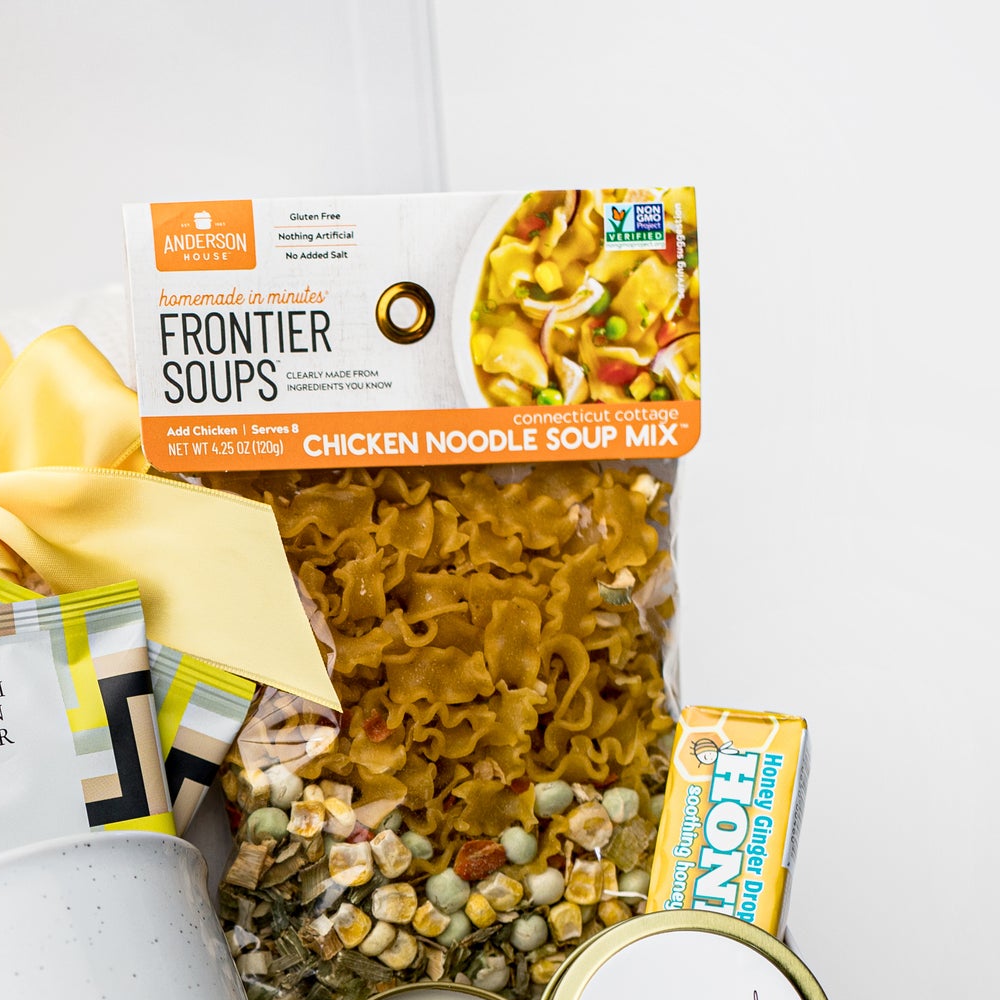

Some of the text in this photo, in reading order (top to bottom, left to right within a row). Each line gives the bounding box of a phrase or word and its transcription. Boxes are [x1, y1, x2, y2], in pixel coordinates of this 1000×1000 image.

[289, 212, 341, 221] Gluten Free
[636, 206, 660, 214] NON
[636, 214, 661, 222] GMO
[636, 222, 661, 230] Project
[164, 233, 247, 254] ANDERSON
[278, 230, 354, 242] Nothing Artificial
[608, 232, 662, 241] VERIFIED
[183, 252, 229, 261] HOUSE
[285, 250, 348, 260] No Added Salt
[674, 203, 687, 299] serving suggestion
[158, 286, 245, 307] homemade
[248, 289, 265, 305] in
[160, 310, 332, 355] FRONTIER
[286, 370, 379, 380] CLEARLY MADE FROM
[286, 381, 393, 392] INGREDIENTS YOU KNOW
[513, 407, 679, 425] connecticut cottage
[167, 423, 299, 437] Add Chicken Serves 8
[168, 440, 284, 456] NET WT 4.25 OZ (120g)
[303, 431, 419, 456] CHICKEN
[426, 428, 538, 453] NOODLE
[546, 425, 617, 449] SOUP
[754, 753, 783, 811] Honey
[692, 751, 760, 916] HON
[664, 785, 702, 910] soothing honey
[746, 814, 773, 876] Ginger
